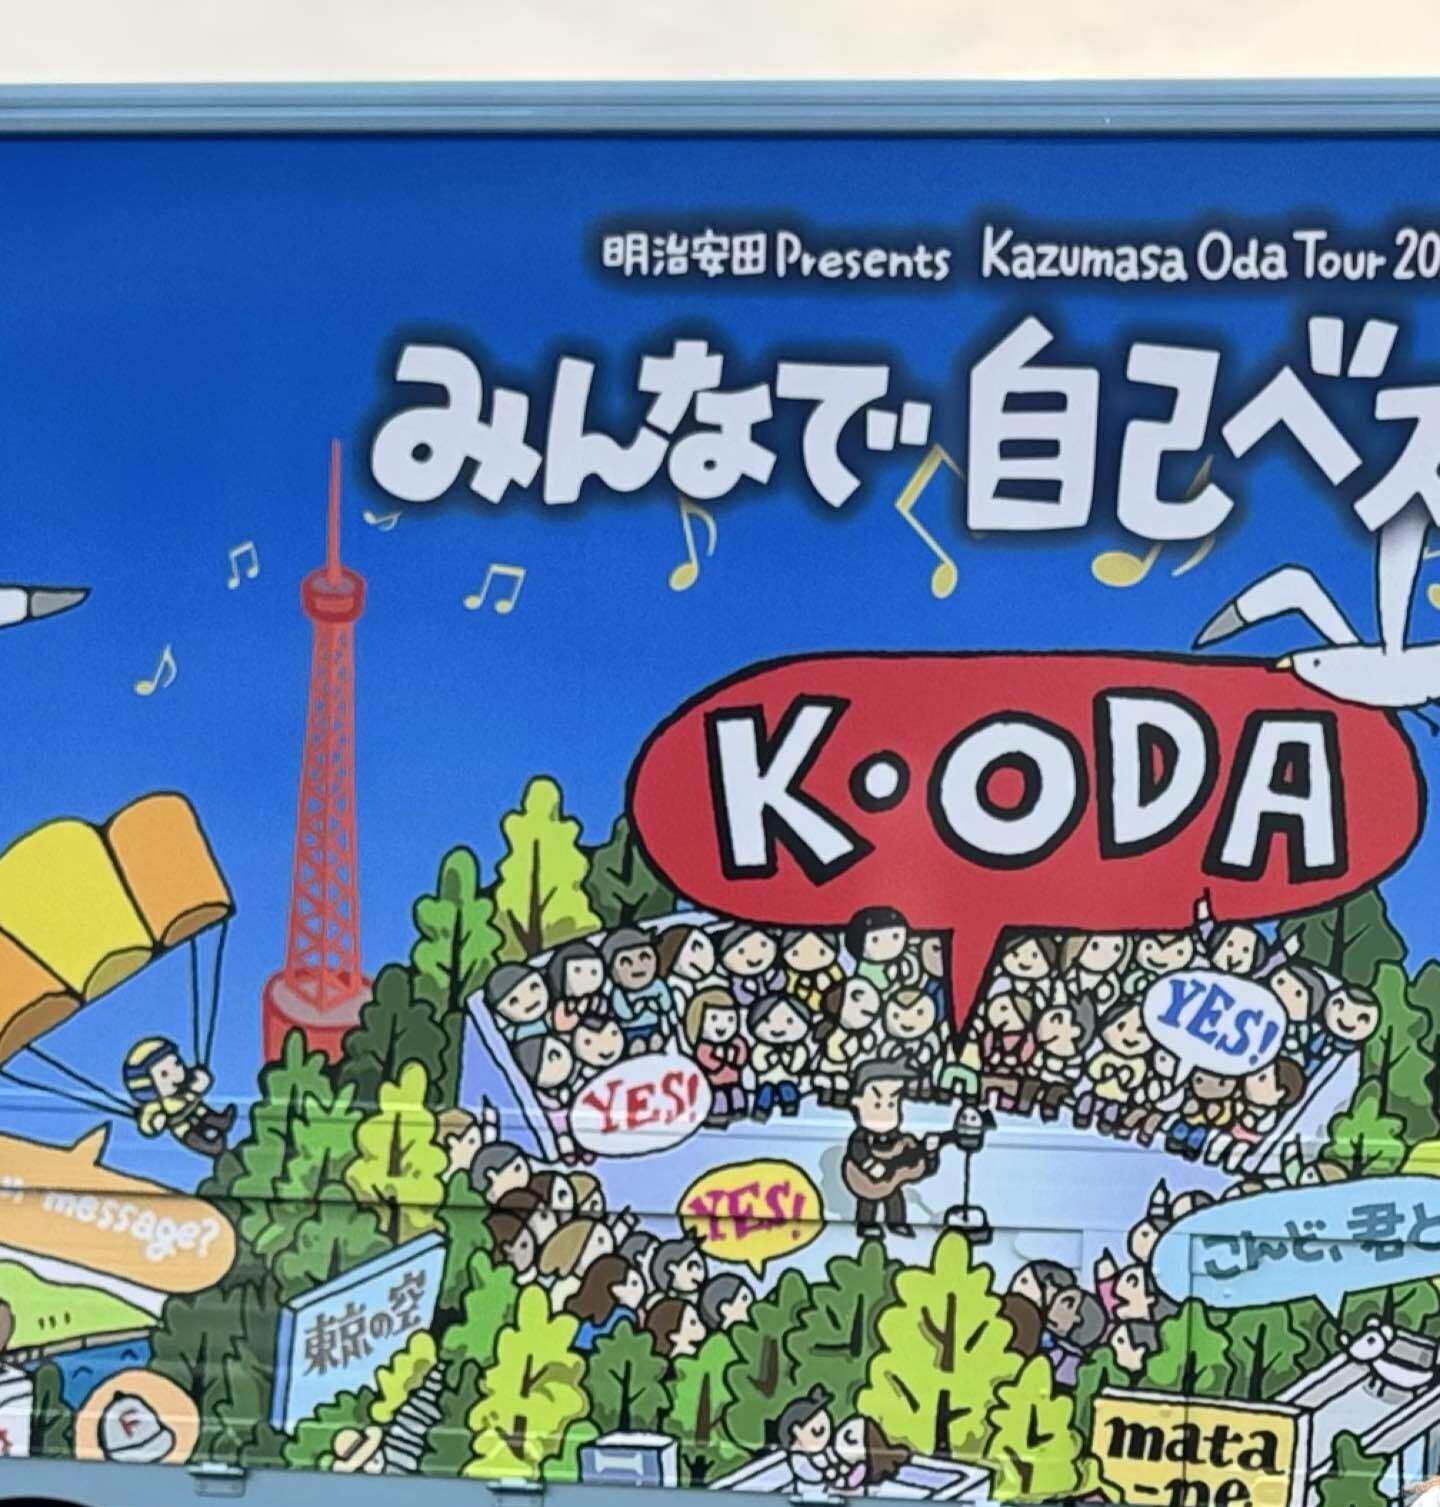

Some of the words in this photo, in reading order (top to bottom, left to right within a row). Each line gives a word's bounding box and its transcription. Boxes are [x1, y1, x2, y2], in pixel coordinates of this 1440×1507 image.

[602, 229, 767, 278] 明治安田
[775, 232, 951, 281] Presents
[981, 226, 1188, 283] Kazumasa
[1196, 231, 1288, 281] Oda
[1292, 230, 1386, 281] Tour
[369, 338, 932, 507] みんなで
[1157, 978, 1279, 1067] YES!
[582, 1071, 700, 1135] YES!
[687, 1181, 807, 1242] YES!
[302, 1268, 427, 1377] 東京の空
[1103, 1415, 1286, 1476] mata
